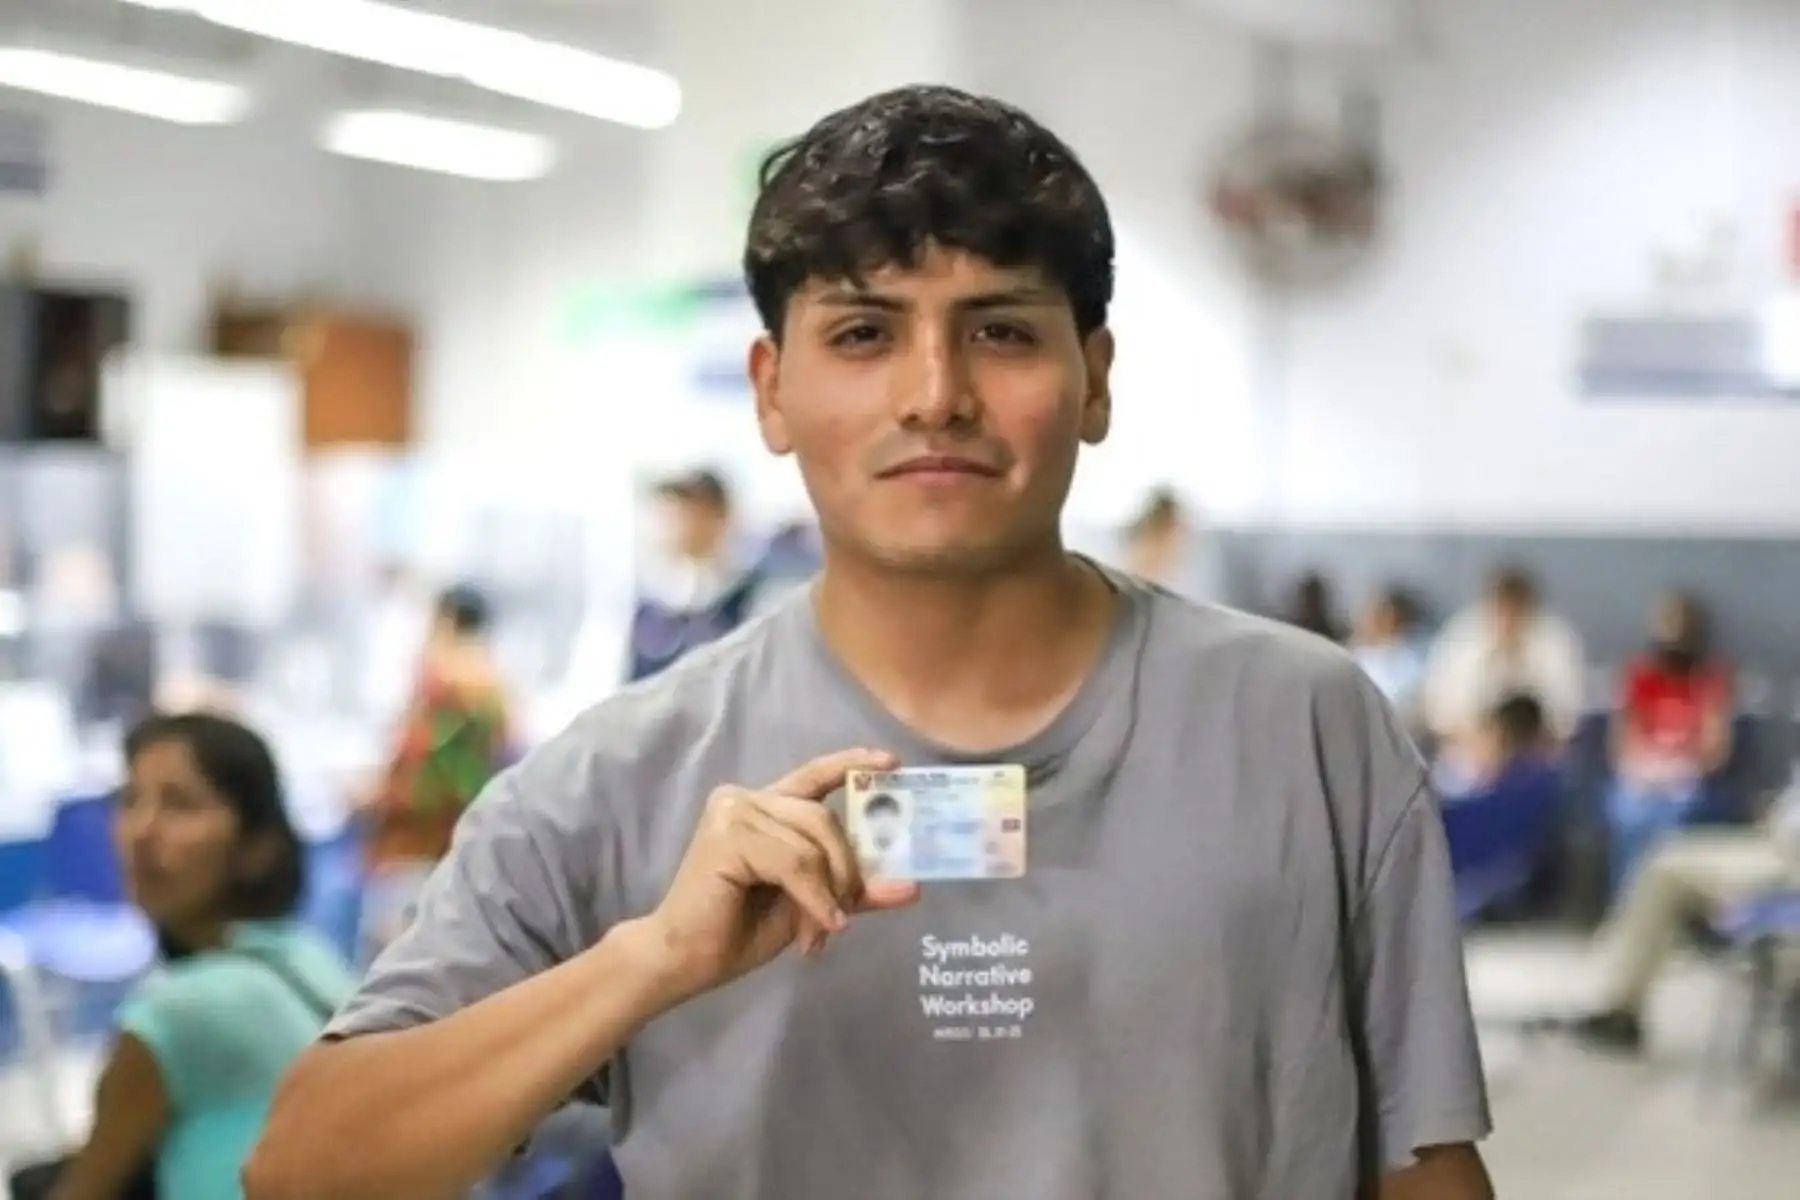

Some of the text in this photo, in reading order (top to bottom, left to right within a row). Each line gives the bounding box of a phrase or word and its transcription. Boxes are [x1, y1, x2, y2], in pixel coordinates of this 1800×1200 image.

[922, 933, 1029, 963] Symbolic
[919, 963, 1033, 987] Narrative
[919, 992, 1034, 1020] Workshop
